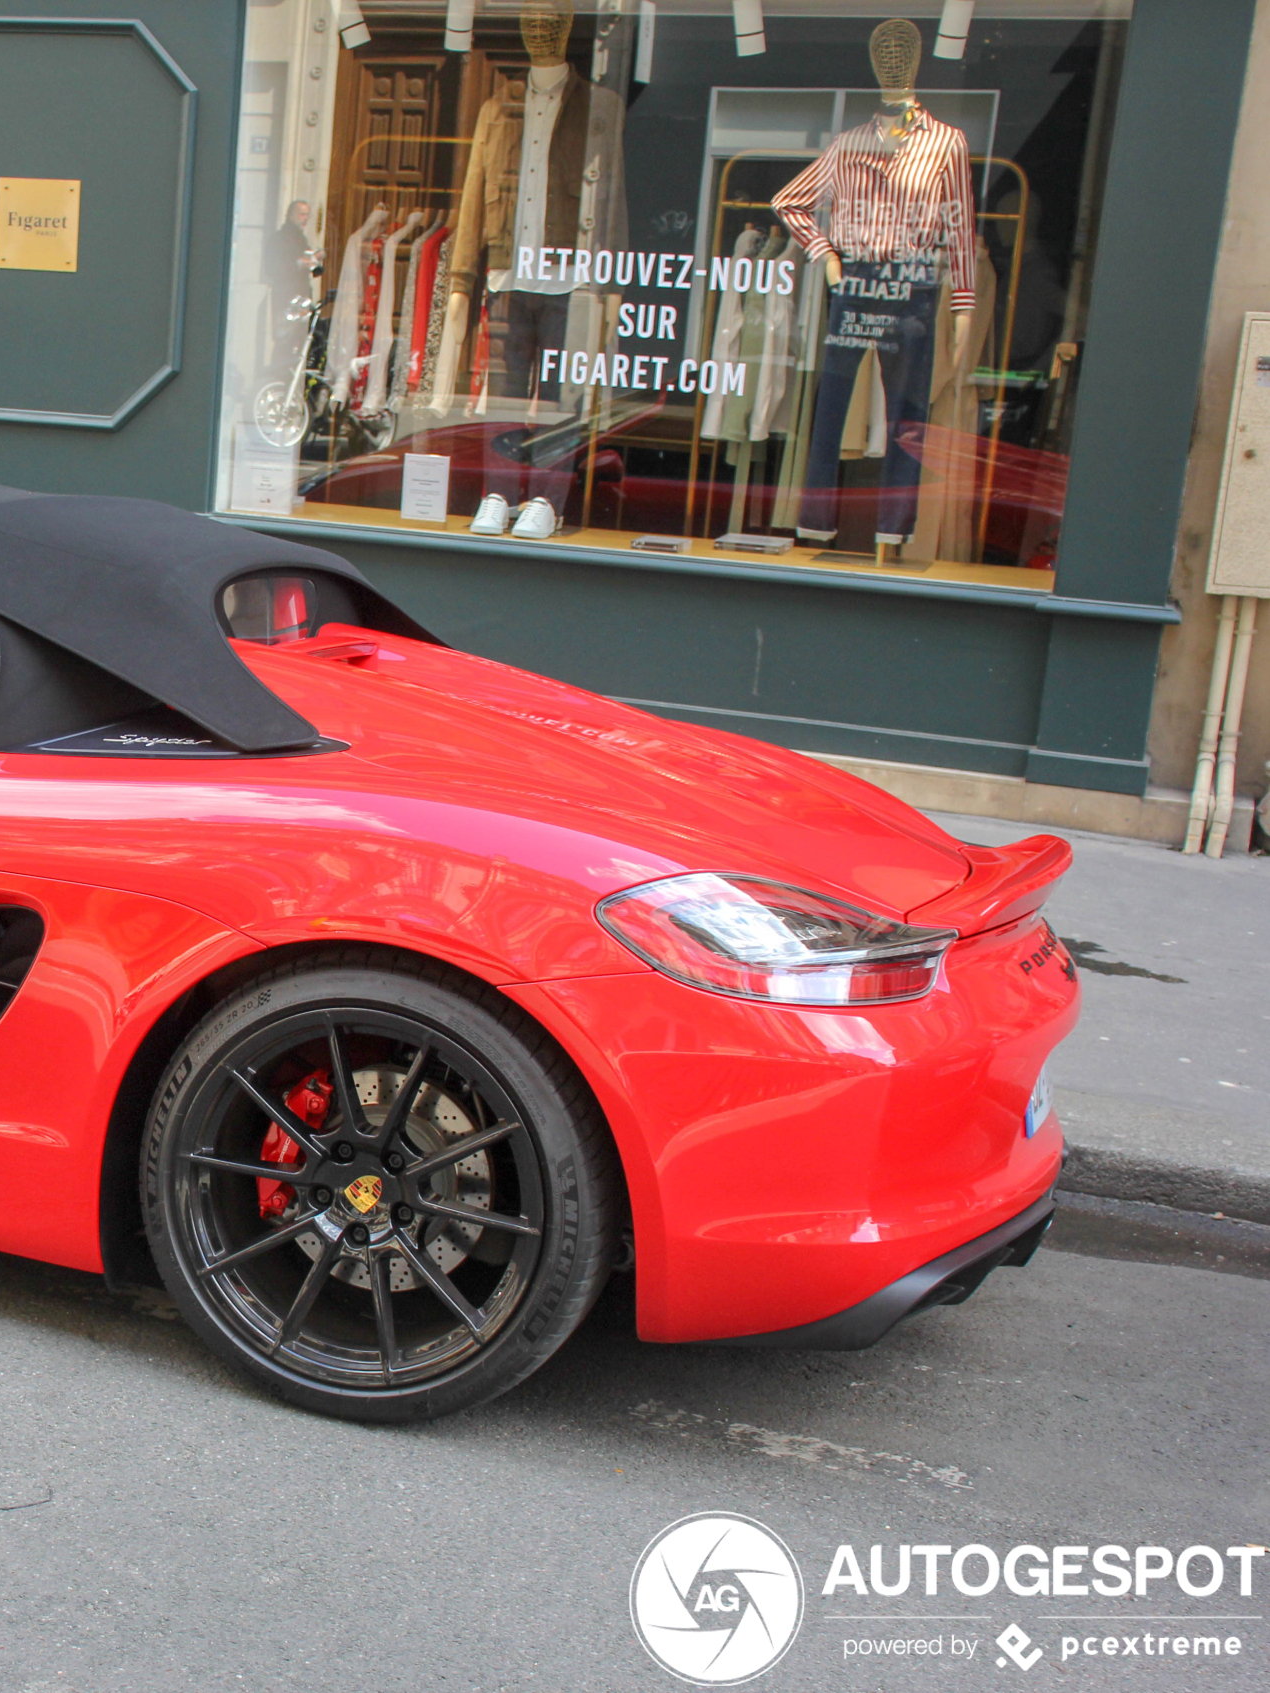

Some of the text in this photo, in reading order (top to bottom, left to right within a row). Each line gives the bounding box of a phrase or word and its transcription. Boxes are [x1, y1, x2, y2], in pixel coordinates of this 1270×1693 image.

[7, 211, 68, 231] Figaret
[516, 246, 796, 295] RETROUVEZ-NOUS
[617, 303, 679, 340] SUR
[540, 349, 747, 397] FIGARET.COM
[103, 734, 212, 747] Spyder
[147, 1066, 189, 1196] MICHELIN
[527, 1199, 579, 1336] MICHELIN
